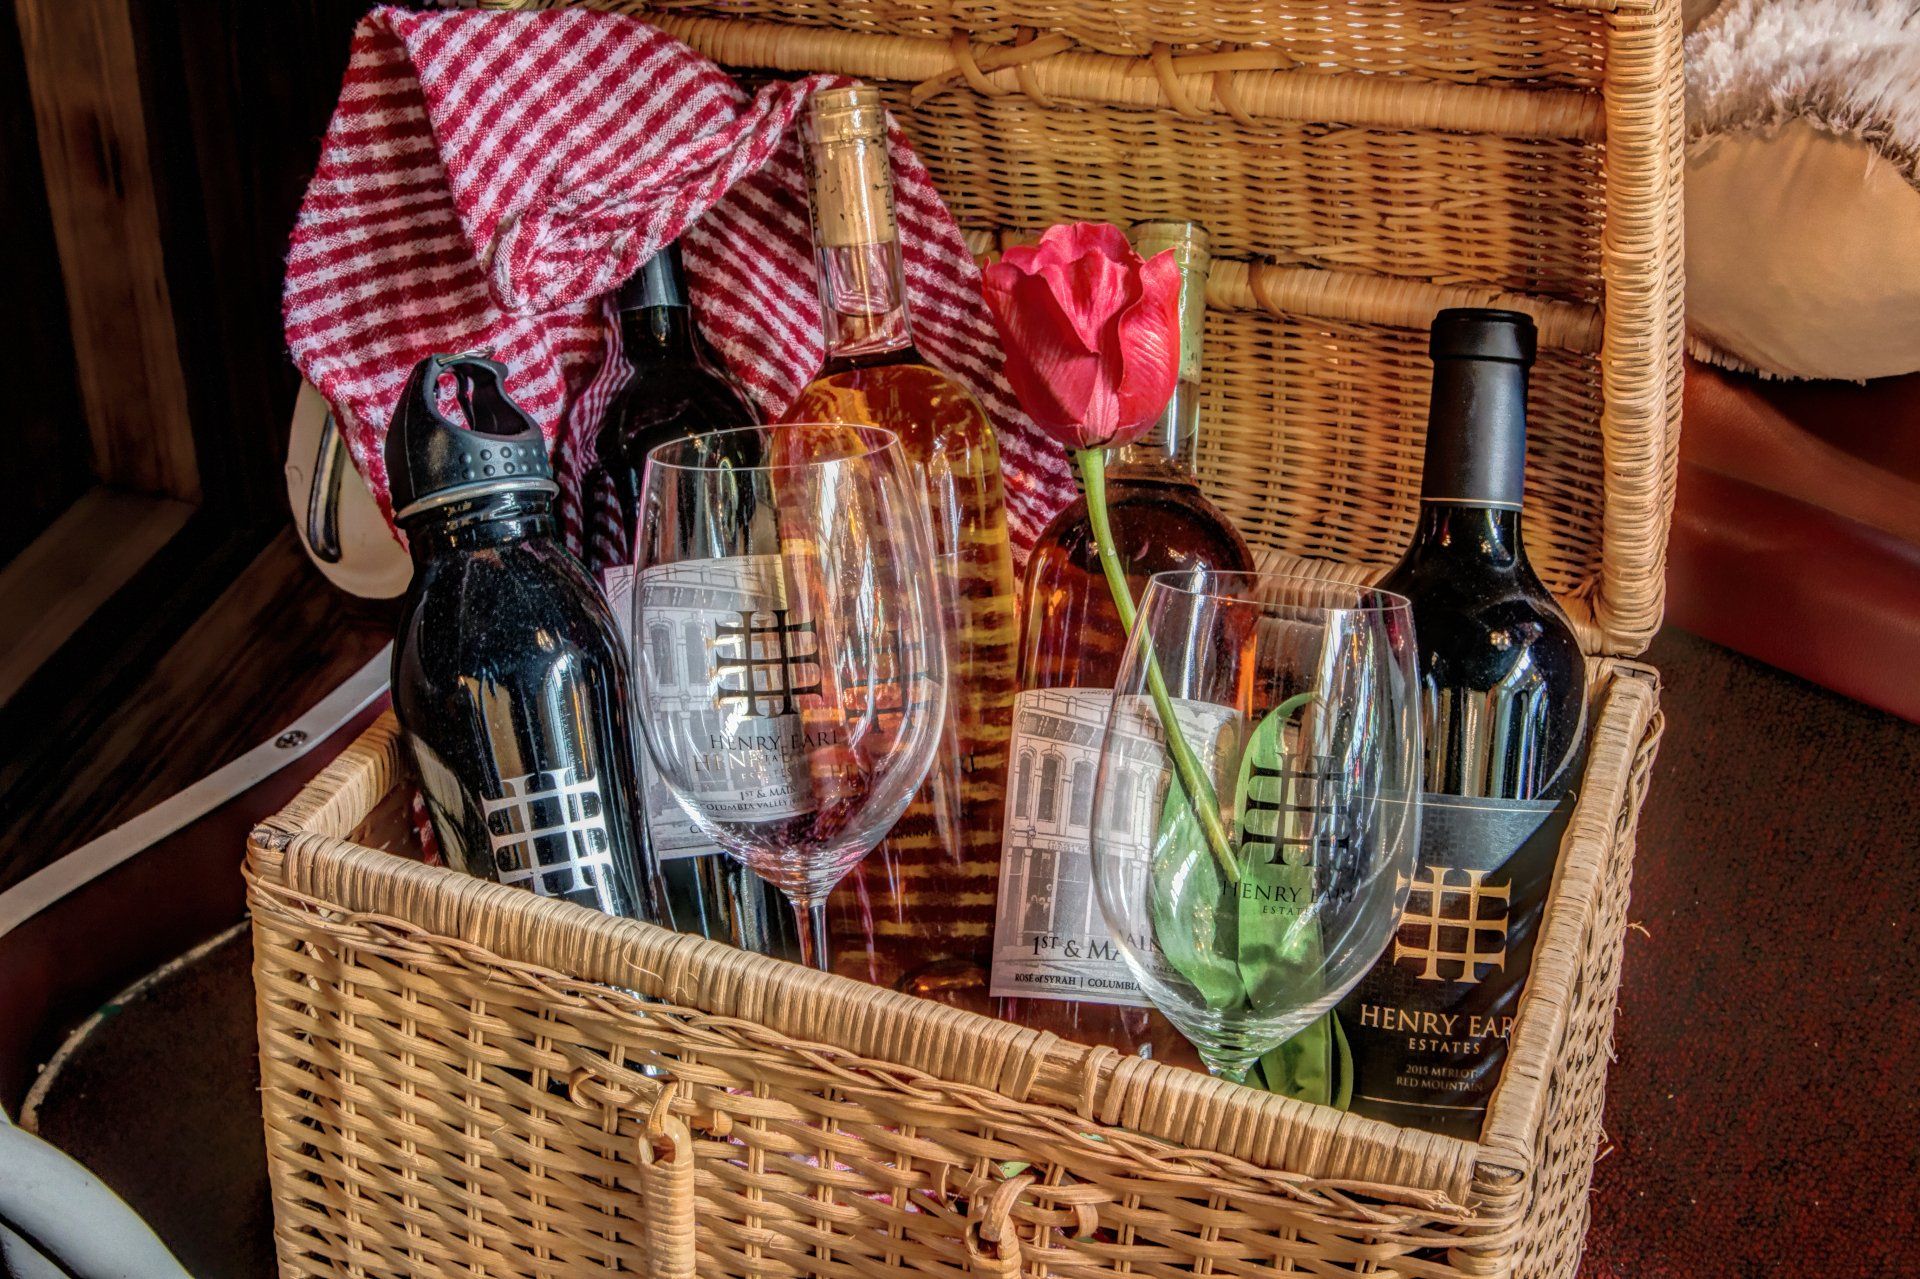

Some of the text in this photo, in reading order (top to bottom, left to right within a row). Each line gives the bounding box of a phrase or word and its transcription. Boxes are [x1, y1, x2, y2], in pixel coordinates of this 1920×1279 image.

[710, 734, 780, 751] HENRY
[757, 789, 767, 799] &
[769, 785, 798, 797] MAIN
[757, 799, 788, 810] VALLEY
[1223, 880, 1303, 903] HENRY
[1032, 935, 1059, 956] 1ST
[1063, 939, 1082, 958] &
[1014, 972, 1142, 992] ROSÉ of SYRAH COLUMBIA
[1359, 1003, 1513, 1040] HENRY EAR
[1408, 1037, 1481, 1055] ESTATES
[1405, 1063, 1478, 1079] 2015 MERLOT
[1396, 1075, 1484, 1092] RED MOUNTAIN
